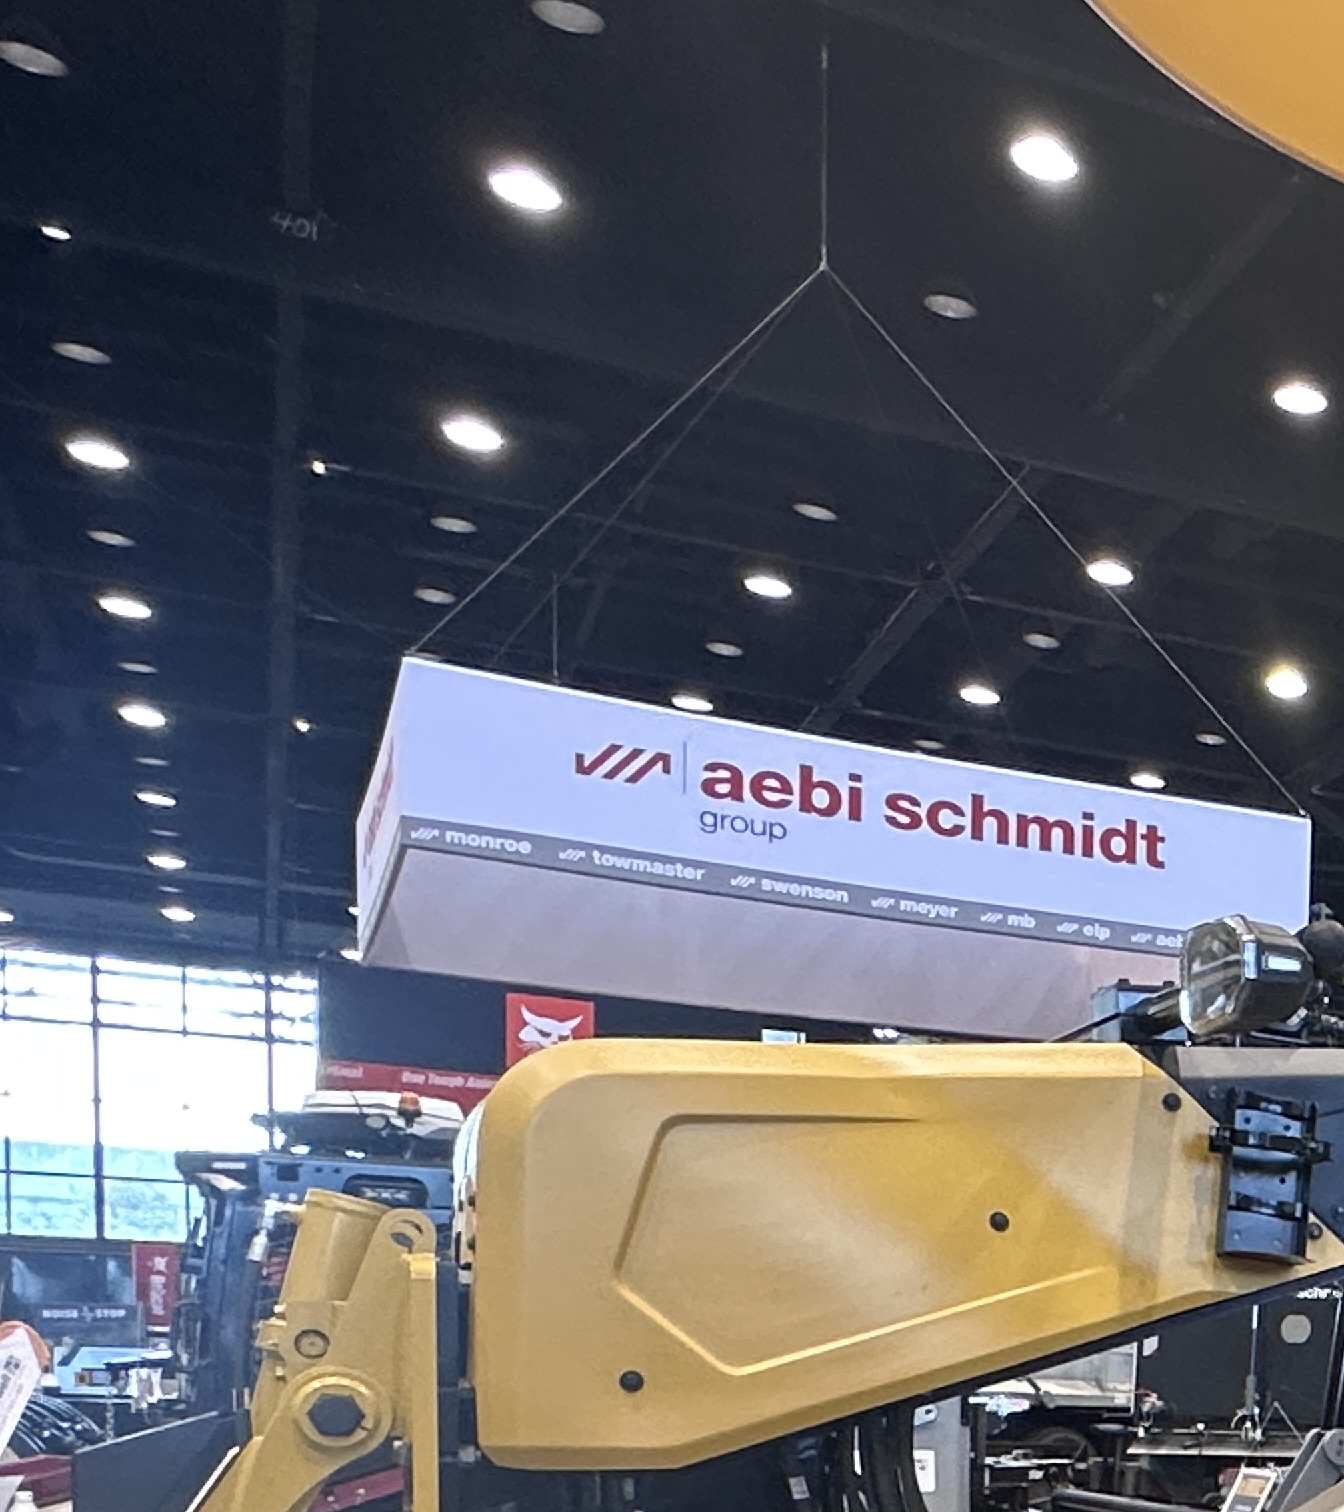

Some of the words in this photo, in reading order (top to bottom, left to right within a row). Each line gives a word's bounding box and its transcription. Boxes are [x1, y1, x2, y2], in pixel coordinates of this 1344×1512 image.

[699, 809, 788, 844] group
[700, 760, 864, 823] aebi
[883, 793, 1166, 870] schmidt
[444, 830, 532, 855] monroe
[592, 849, 706, 882] towmaster
[760, 876, 850, 904] swenson
[899, 898, 959, 920] meyer
[1007, 910, 1036, 929] mb
